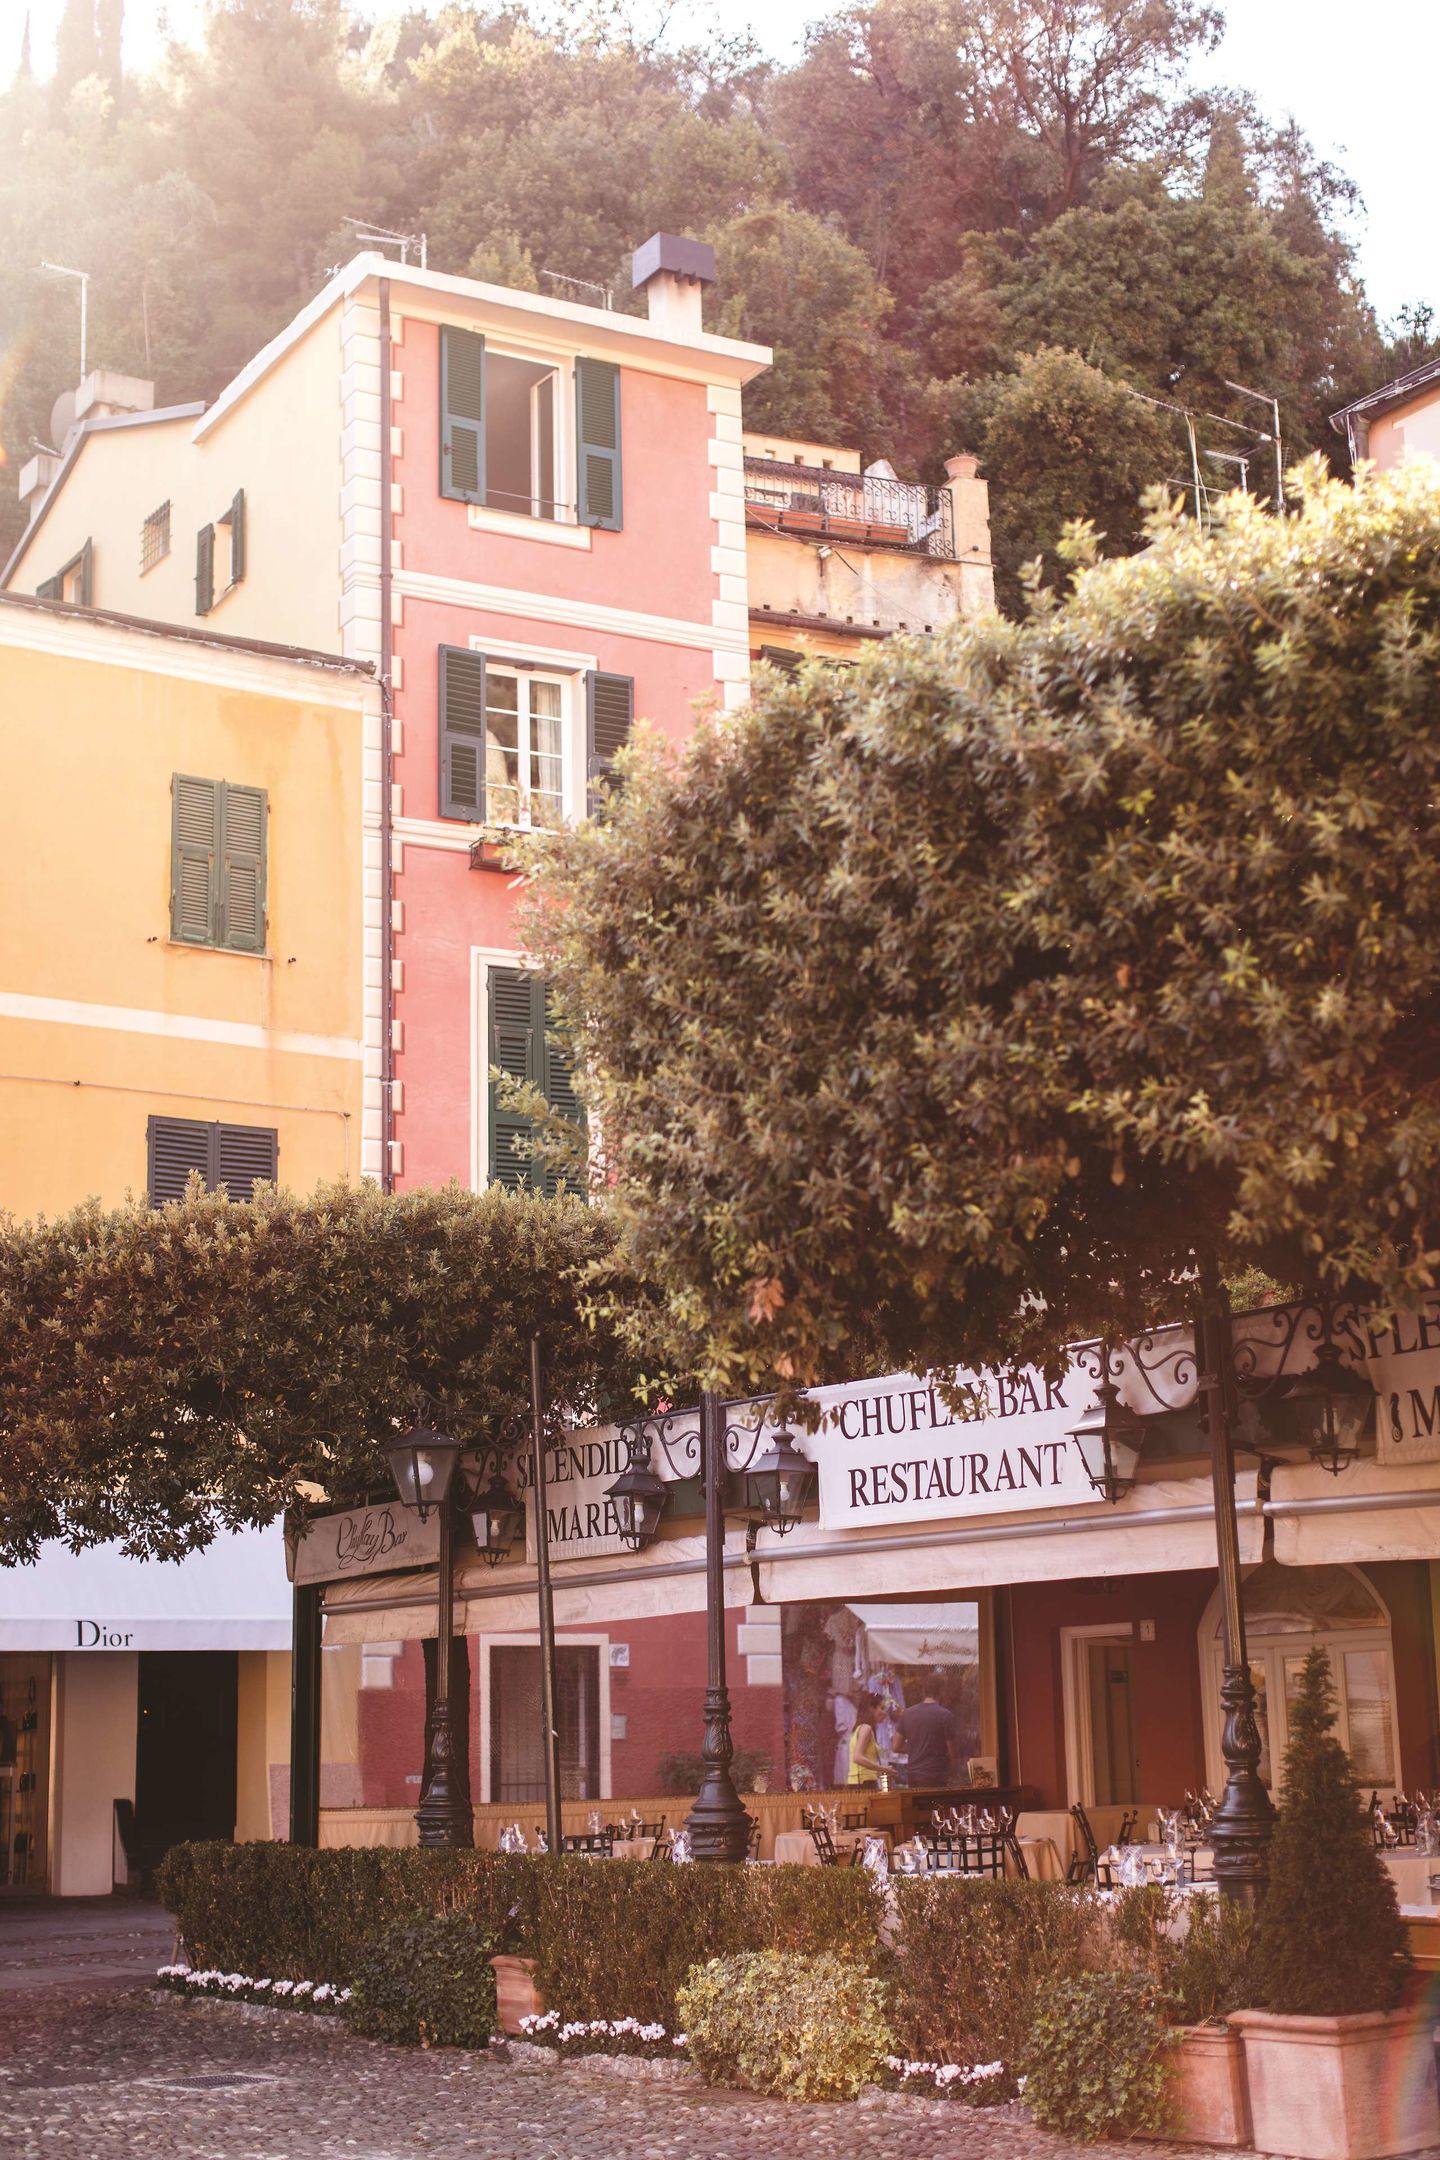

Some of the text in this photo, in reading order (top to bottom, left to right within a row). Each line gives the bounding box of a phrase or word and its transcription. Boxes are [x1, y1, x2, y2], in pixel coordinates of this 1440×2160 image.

[996, 1371, 1069, 1418] BAR
[848, 1442, 1067, 1508] RESTAURANT
[369, 1507, 408, 1565] Bar
[547, 1500, 619, 1543] MARE
[74, 1620, 134, 1647] Dior
